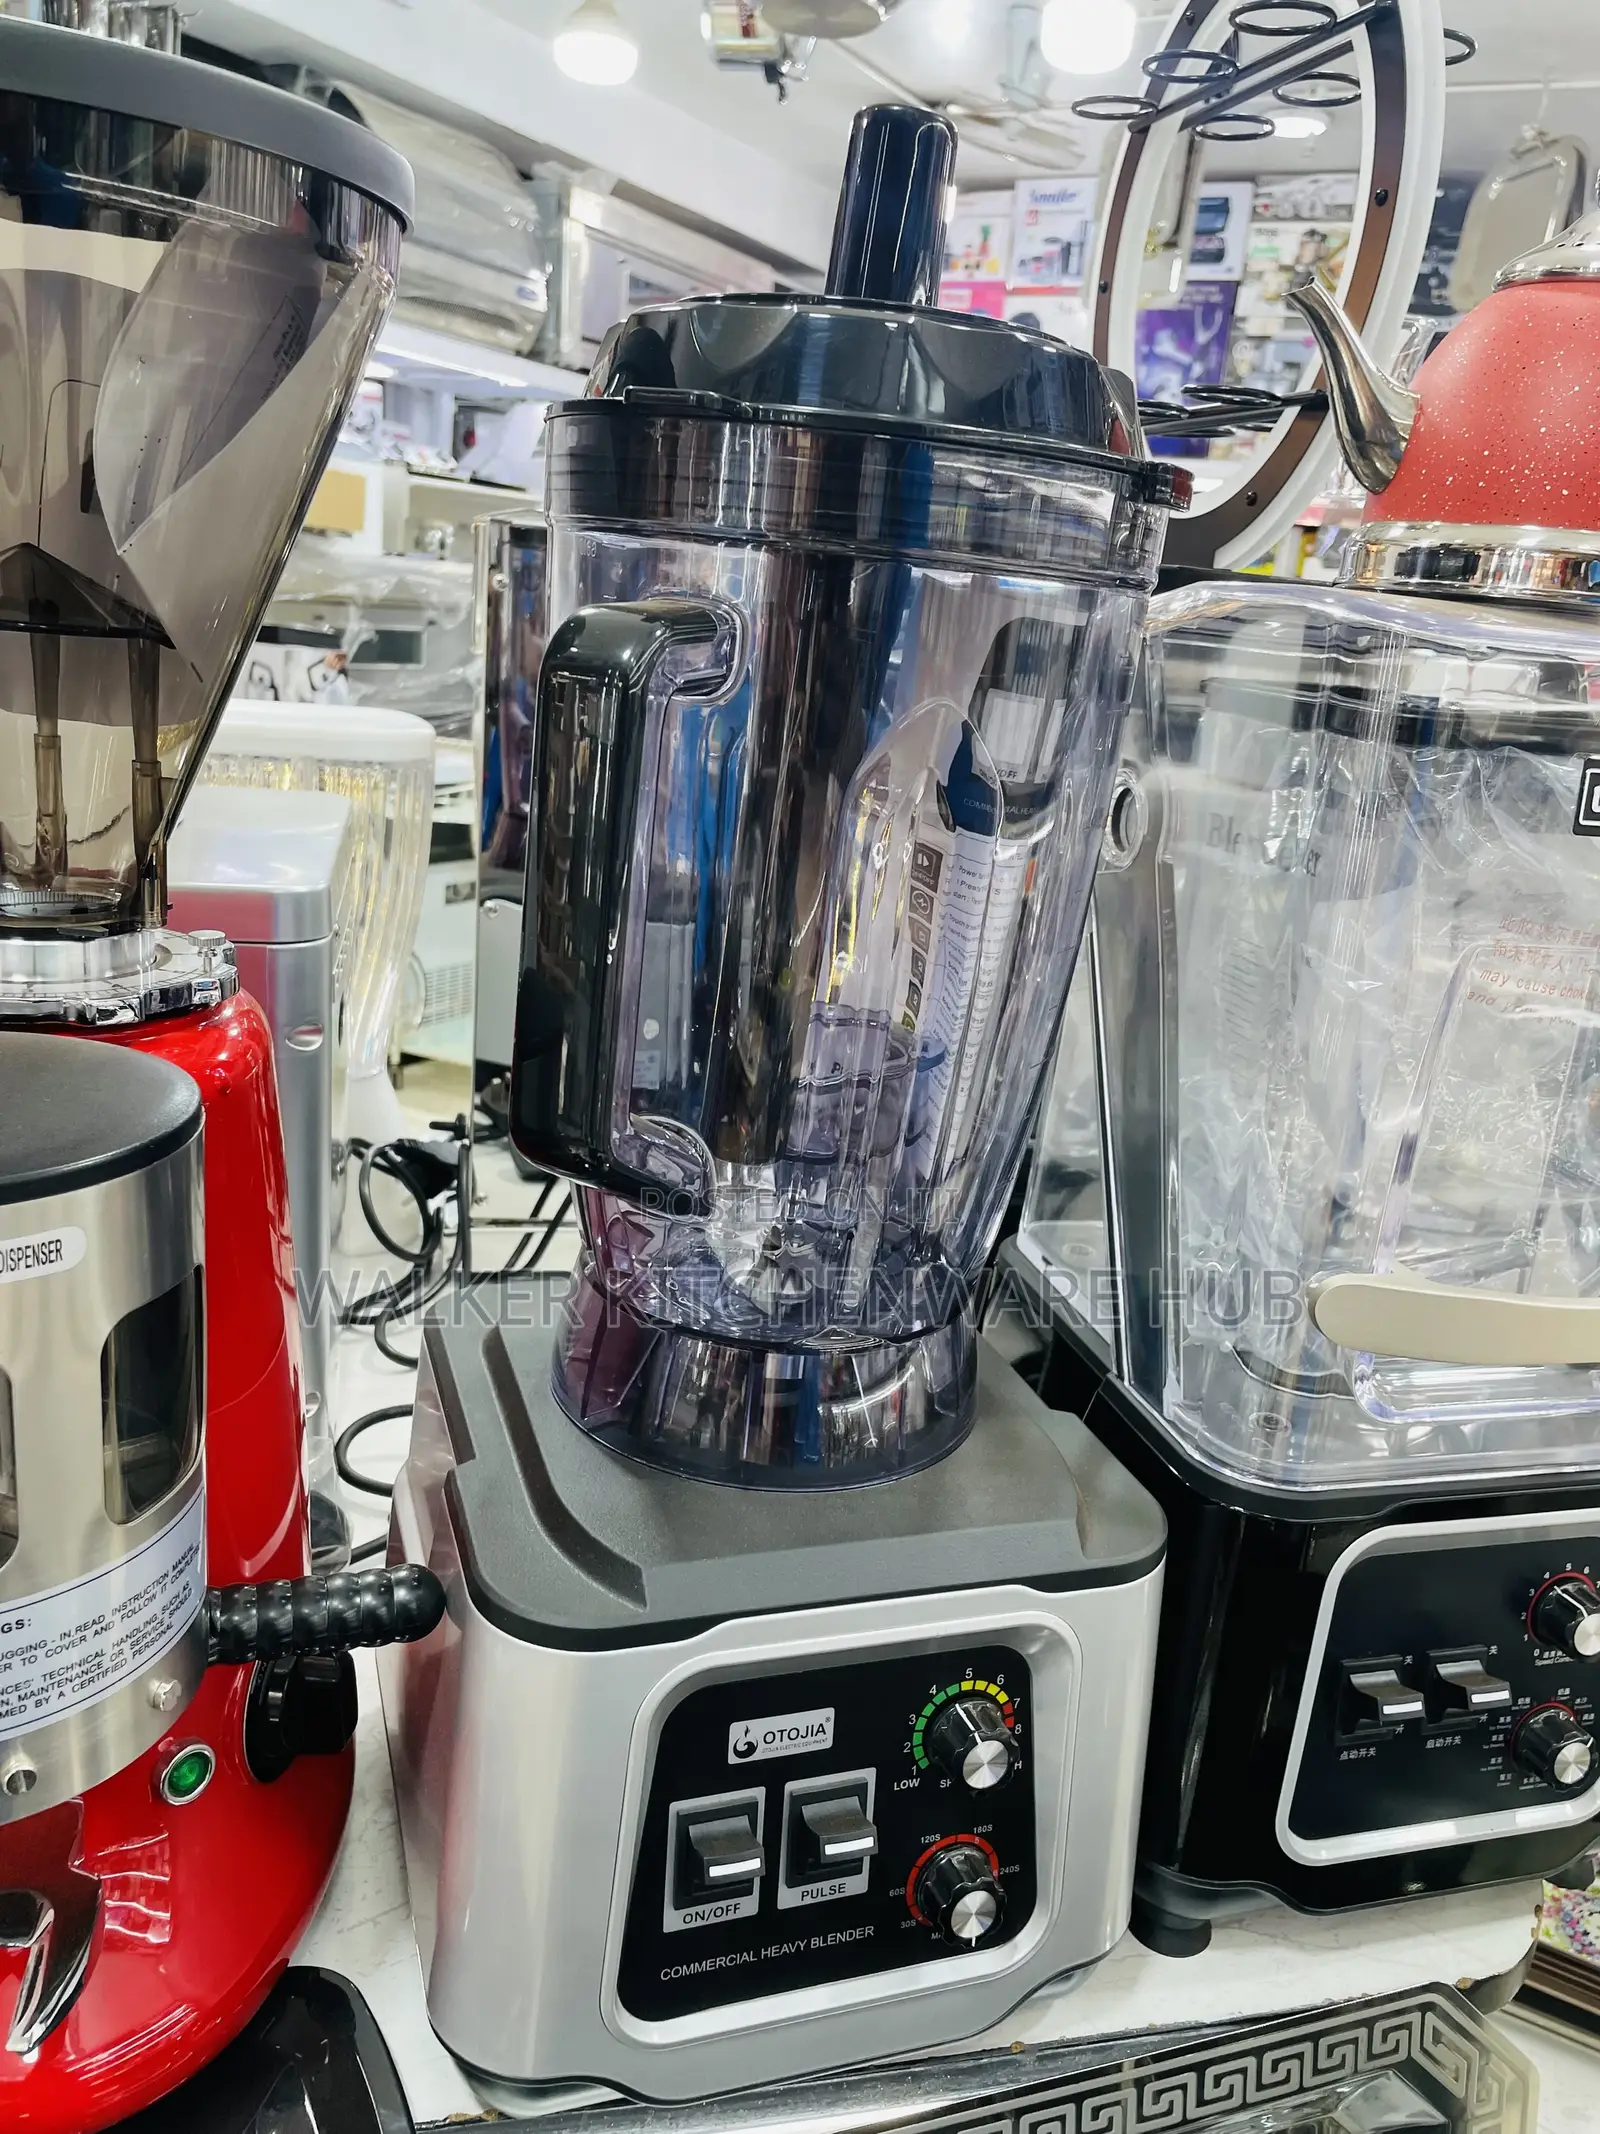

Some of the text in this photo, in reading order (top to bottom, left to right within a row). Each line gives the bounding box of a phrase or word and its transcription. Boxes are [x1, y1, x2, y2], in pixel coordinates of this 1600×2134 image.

[1479, 969, 1511, 988] may
[1516, 977, 1557, 997] cause
[0, 1239, 63, 1274] DISPENSER
[1565, 1562, 1572, 1571] 5
[1583, 1566, 1590, 1574] 6
[1543, 1571, 1550, 1579] 4
[111, 1571, 170, 1617] INSTRUCTION
[1528, 1588, 1535, 1596] 3
[1520, 1612, 1527, 1620] 2
[20, 1654, 38, 1667] TO
[45, 1634, 88, 1659] COVER
[93, 1620, 115, 1639] AND
[120, 1590, 158, 1623] FOLLOW
[160, 1581, 168, 1595] IT
[41, 1648, 107, 1683] TECHNICAL
[161, 1591, 181, 1616] SUCH
[182, 1580, 190, 1593] AS
[1523, 1633, 1529, 1641] 1
[18, 1660, 104, 1703] MAINTENANCE
[109, 1649, 125, 1662] OR
[129, 1618, 165, 1651] SERVICE
[168, 1587, 192, 1619] SHOULD
[1488, 1645, 1498, 1655] 关
[1533, 1648, 1540, 1657] 0
[35, 1694, 51, 1708] BY
[58, 1690, 66, 1700] A
[72, 1657, 128, 1693] CERTIFIED
[132, 1622, 174, 1660] PERSONAL
[1403, 1655, 1414, 1665] 关
[965, 1668, 973, 1679] 5
[996, 1674, 1005, 1685] 6
[929, 1684, 937, 1695] 4
[1013, 1698, 1020, 1708] 7
[908, 1714, 916, 1725] 3
[1014, 1723, 1022, 1735] 8
[903, 1742, 911, 1753] 2
[1339, 1747, 1377, 1761] 点动开关
[911, 1765, 917, 1776] 1
[893, 1778, 921, 1791] LOW
[973, 1824, 993, 1834] 180S
[920, 1833, 941, 1844] 120S
[1000, 1865, 1020, 1875] 240S
[801, 1883, 847, 1902] PULSE
[889, 1887, 906, 1897] 60S
[682, 1903, 741, 1925] ON/OFF
[900, 1919, 917, 1929] 30S
[660, 1925, 875, 1981] COMMERCIAL HEAVY BLENDER
